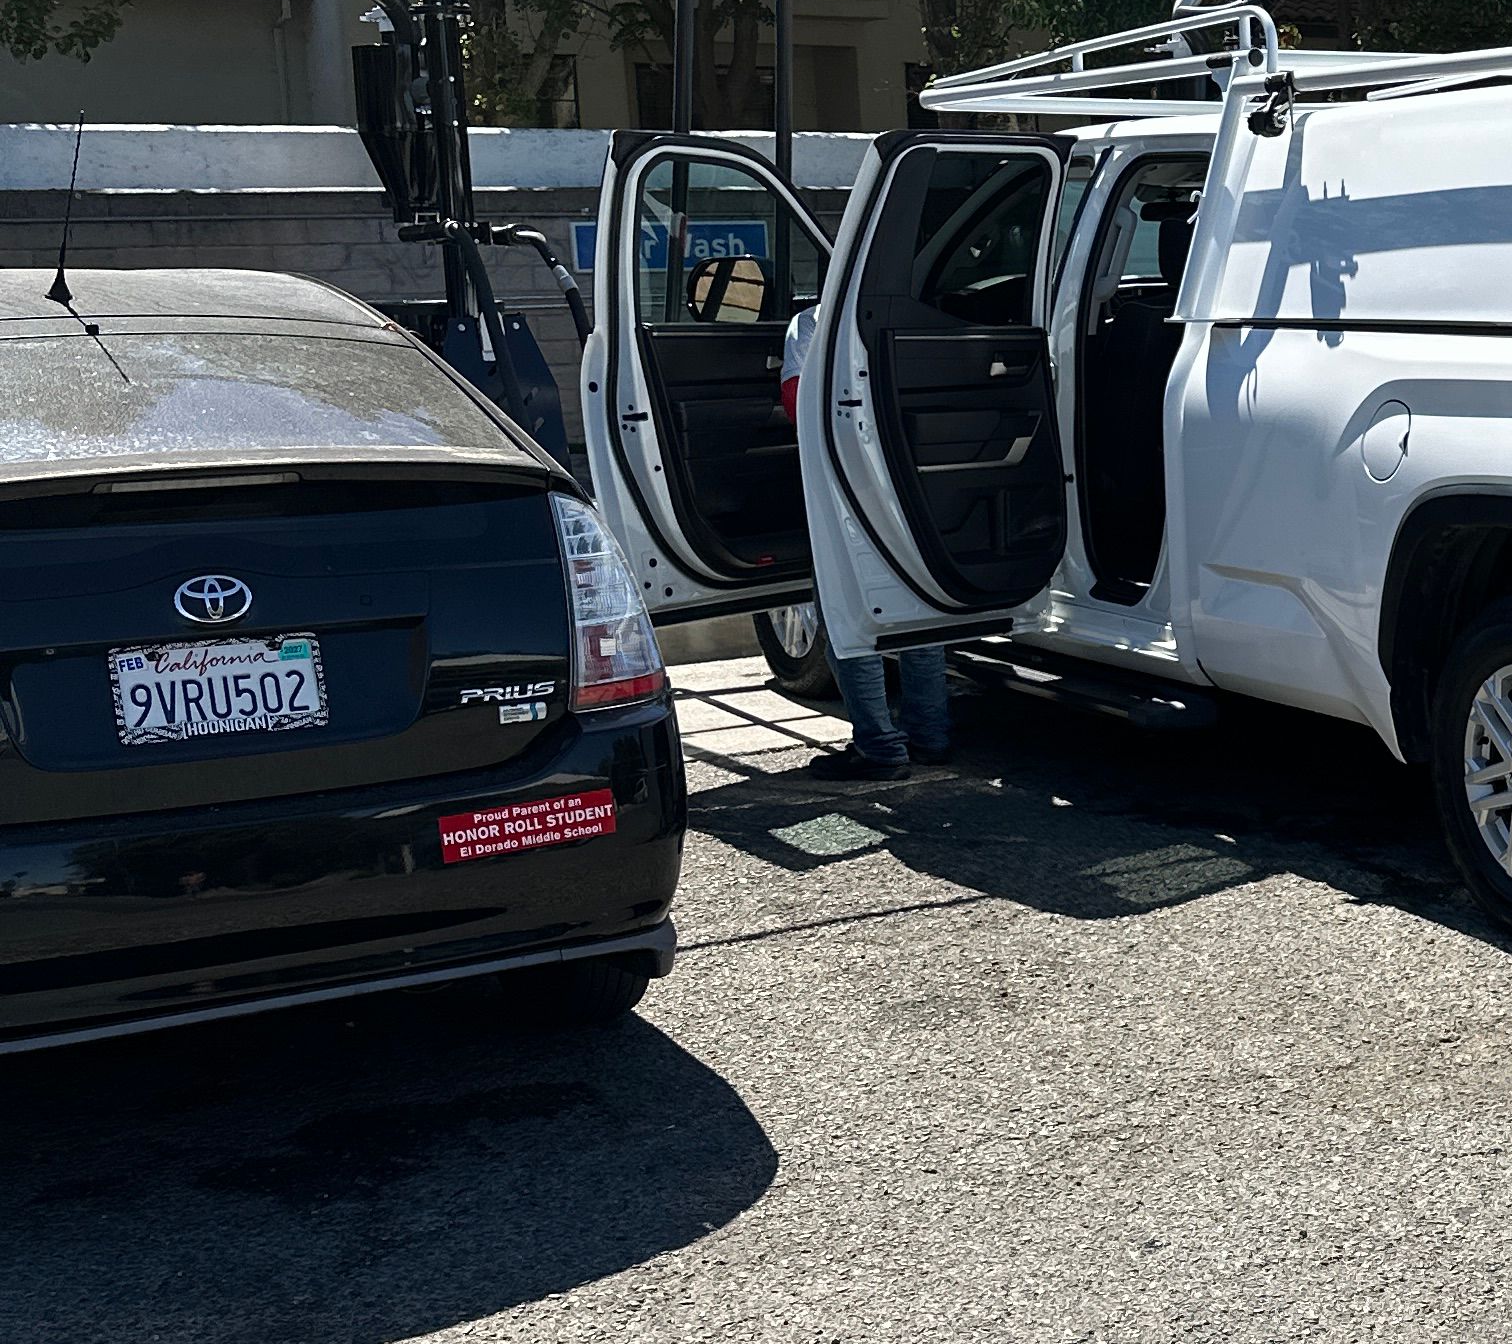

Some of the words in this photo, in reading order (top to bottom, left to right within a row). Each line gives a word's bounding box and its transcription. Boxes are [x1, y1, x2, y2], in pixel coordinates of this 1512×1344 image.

[684, 233, 745, 259] ash
[119, 657, 144, 672] FEB
[154, 649, 279, 676] California
[130, 670, 310, 727] 9VRU502
[459, 681, 556, 704] PRIUS
[474, 810, 509, 824] Proud
[512, 801, 551, 817] Parent
[553, 798, 565, 810] of
[568, 797, 582, 807] an
[443, 825, 500, 846] HONOR
[504, 818, 543, 835] ROLL
[546, 804, 613, 827] STUDENT
[460, 847, 472, 857] El
[476, 839, 519, 855] Dorado
[522, 831, 561, 846] Middle
[564, 823, 603, 839] School
